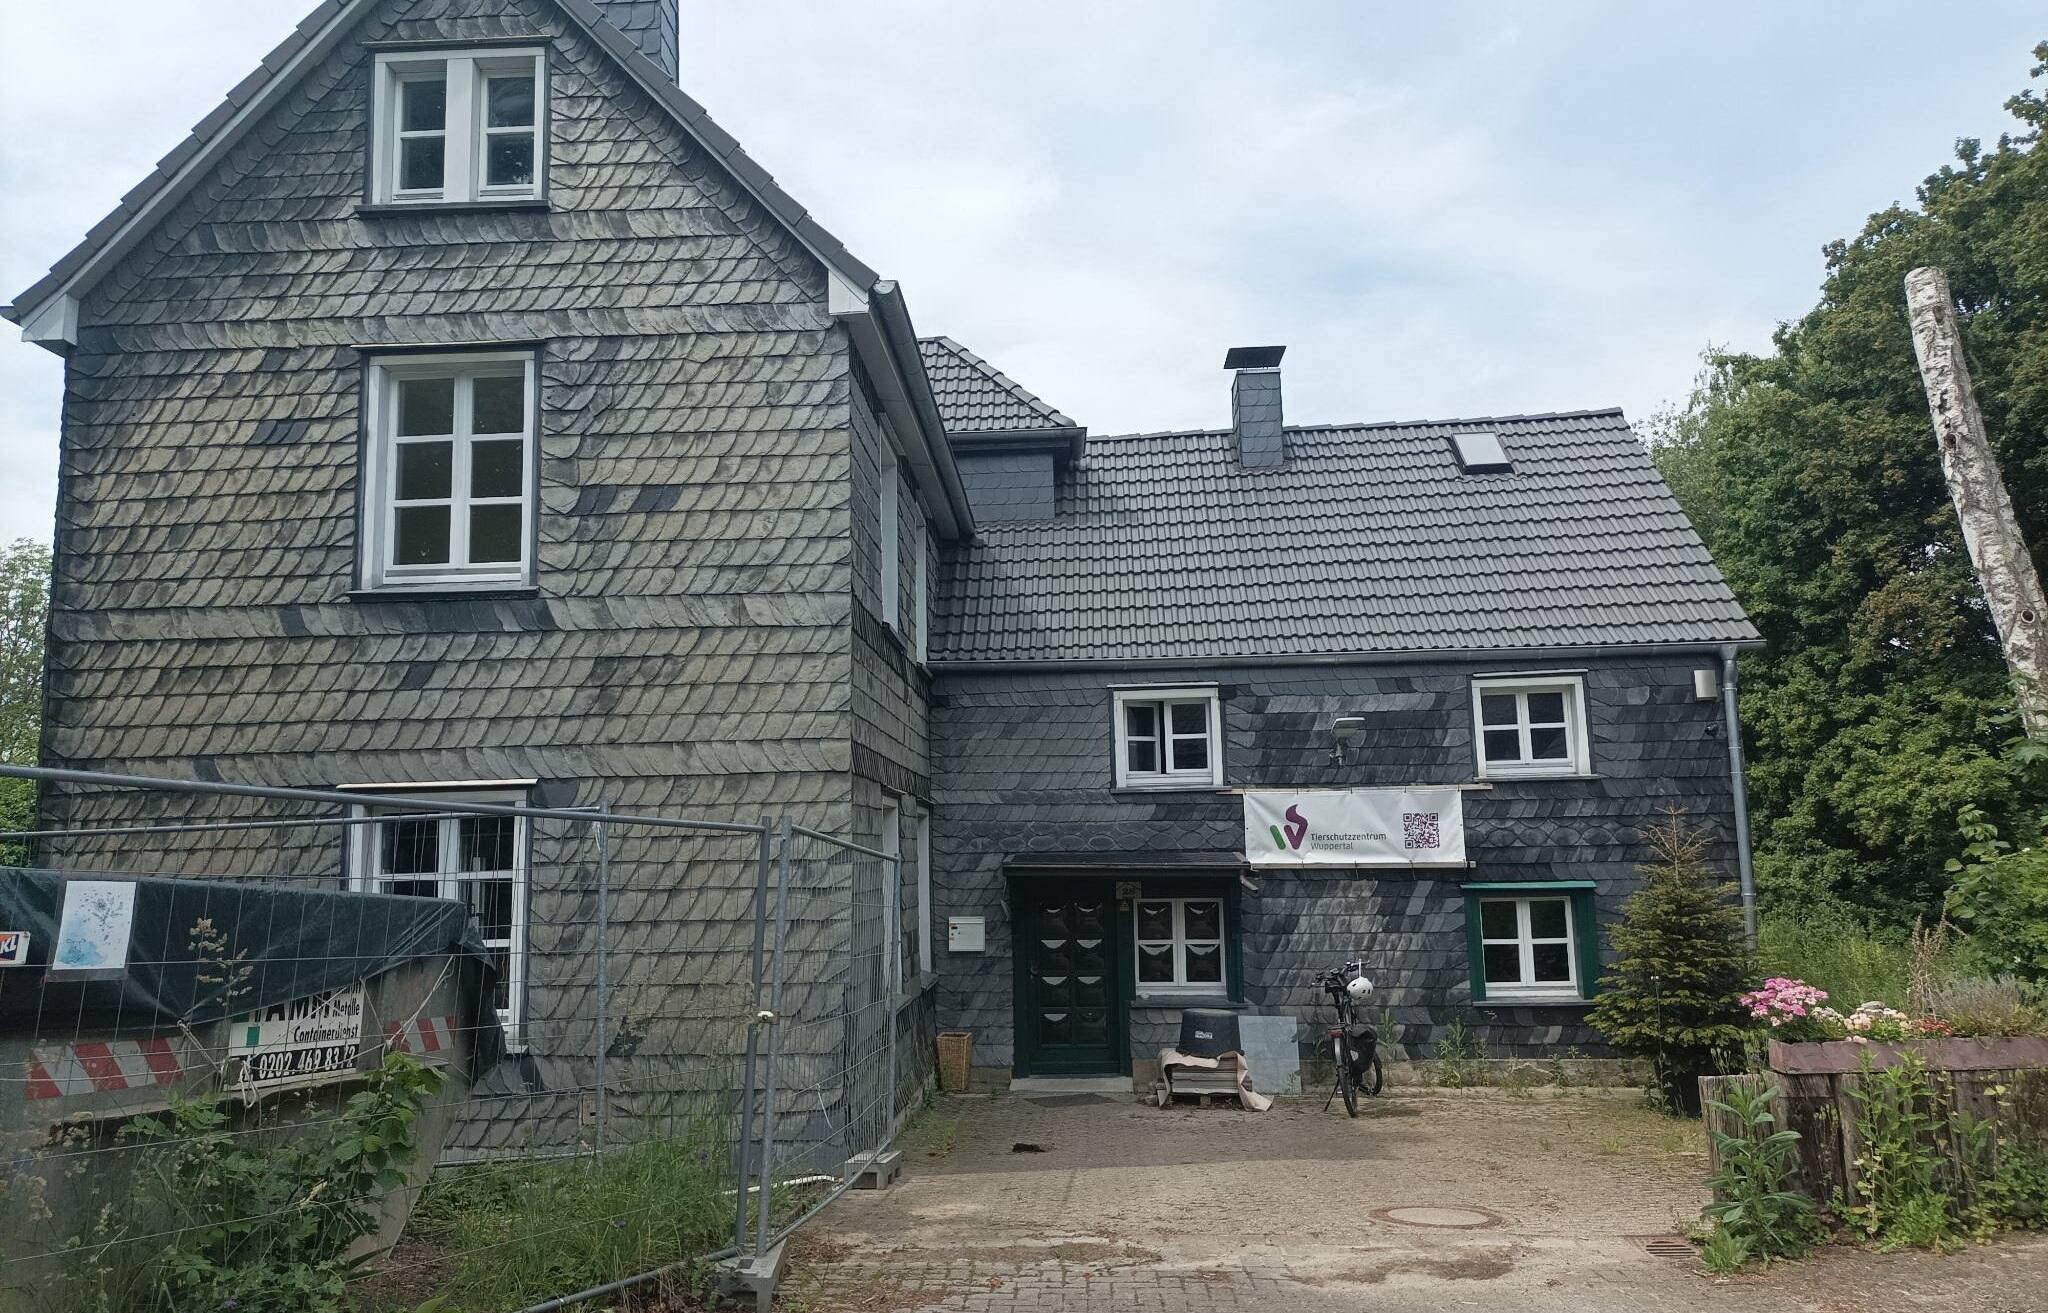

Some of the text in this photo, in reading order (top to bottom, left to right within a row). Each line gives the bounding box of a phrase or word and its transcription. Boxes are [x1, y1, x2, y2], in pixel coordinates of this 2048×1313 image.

[1311, 832, 1387, 841] Tierschutzzentrum
[1311, 842, 1353, 851] Wuppertal
[294, 1021, 358, 1042] Containerdienst
